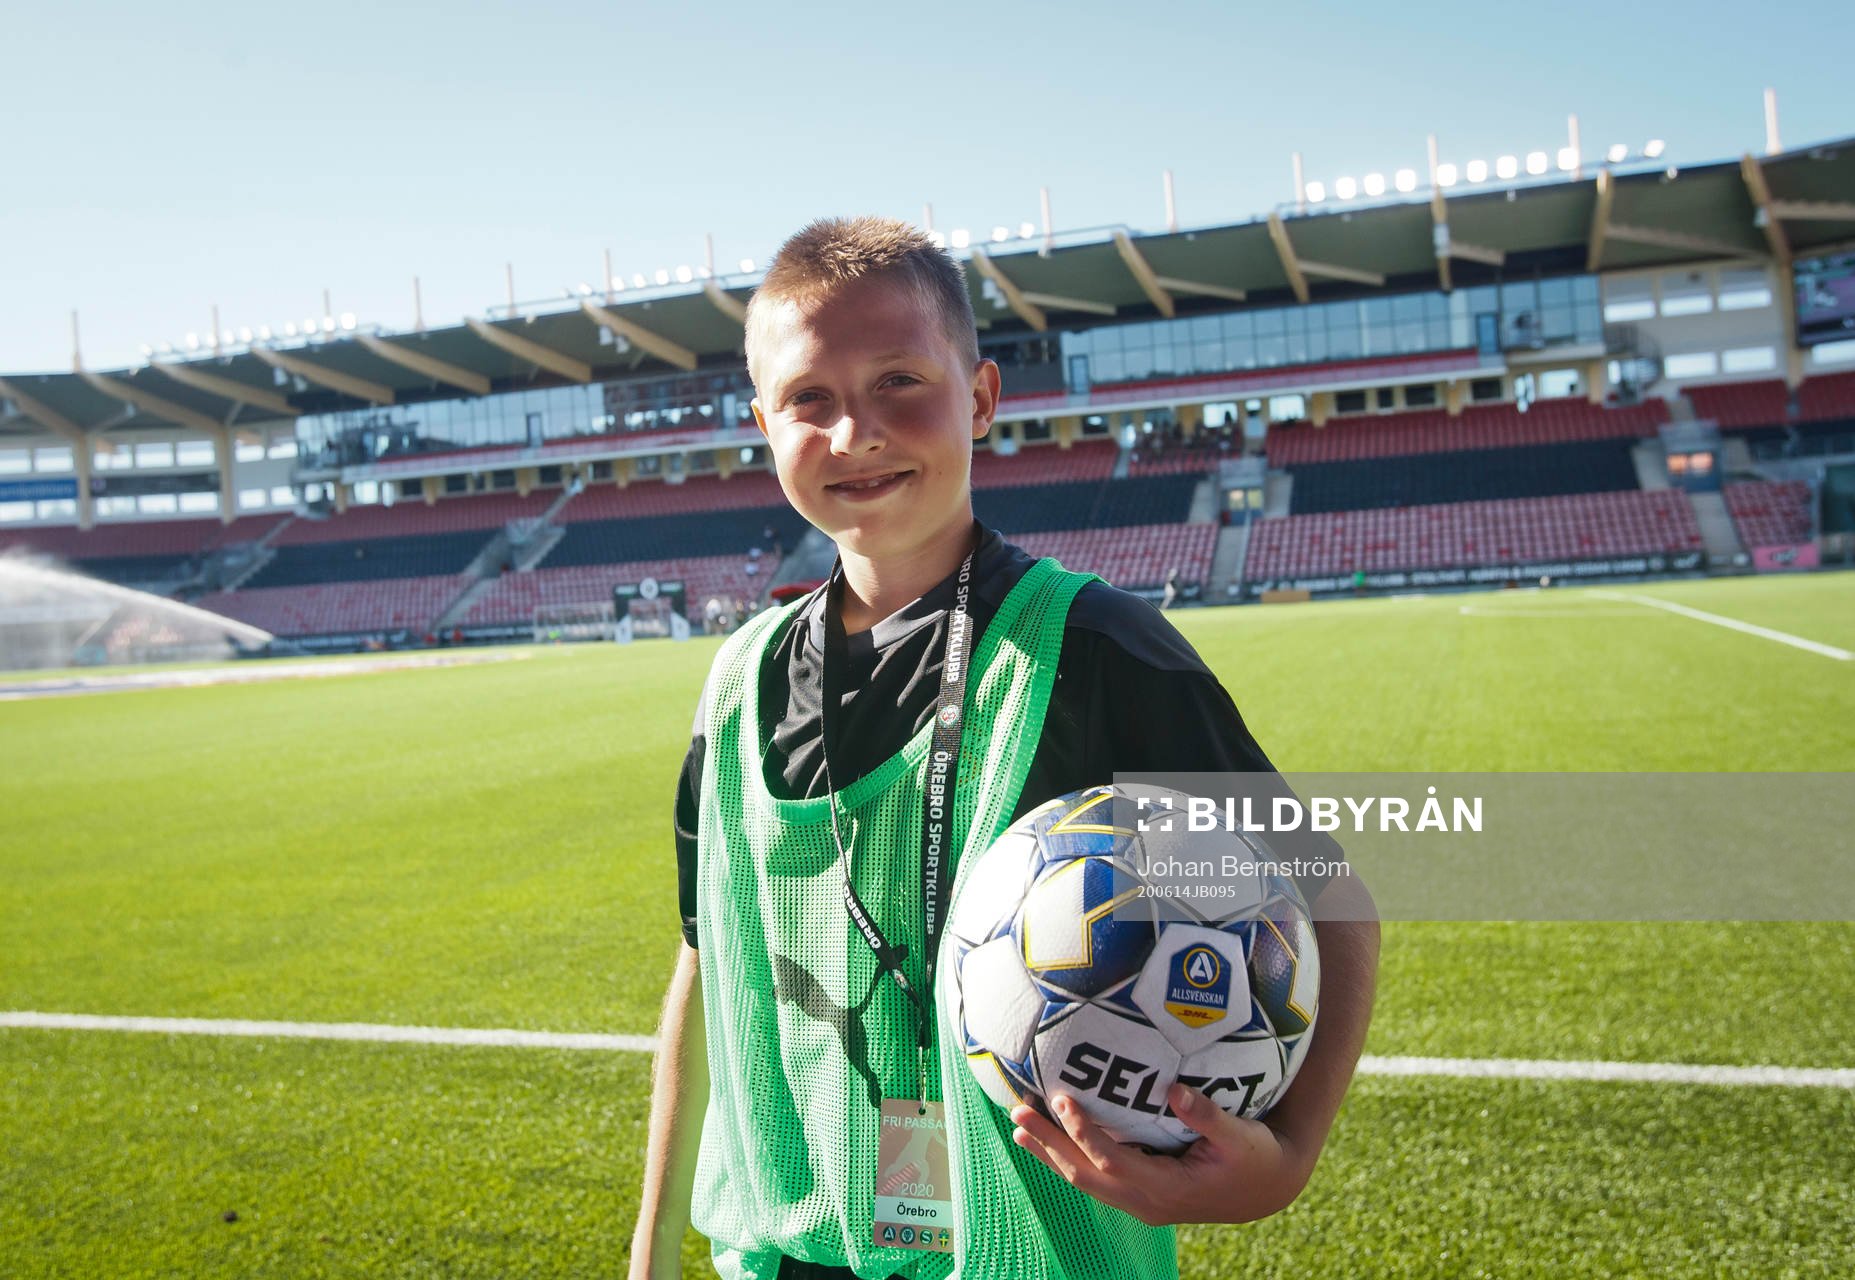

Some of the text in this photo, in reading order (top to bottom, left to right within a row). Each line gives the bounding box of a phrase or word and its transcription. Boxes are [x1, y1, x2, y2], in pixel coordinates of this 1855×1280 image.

[946, 549, 975, 684] BRO SPORTKLUBB
[925, 750, 952, 935] ÖREBRO SPORTKLUBB
[843, 884, 882, 949] ÖREBRO
[1171, 987, 1225, 1005] ALLSVENSKAN
[1181, 1009, 1210, 1019] DHL
[882, 1115, 946, 1130] FRI PASSA
[901, 1182, 934, 1198] 2020
[896, 1202, 937, 1218] Örebro
